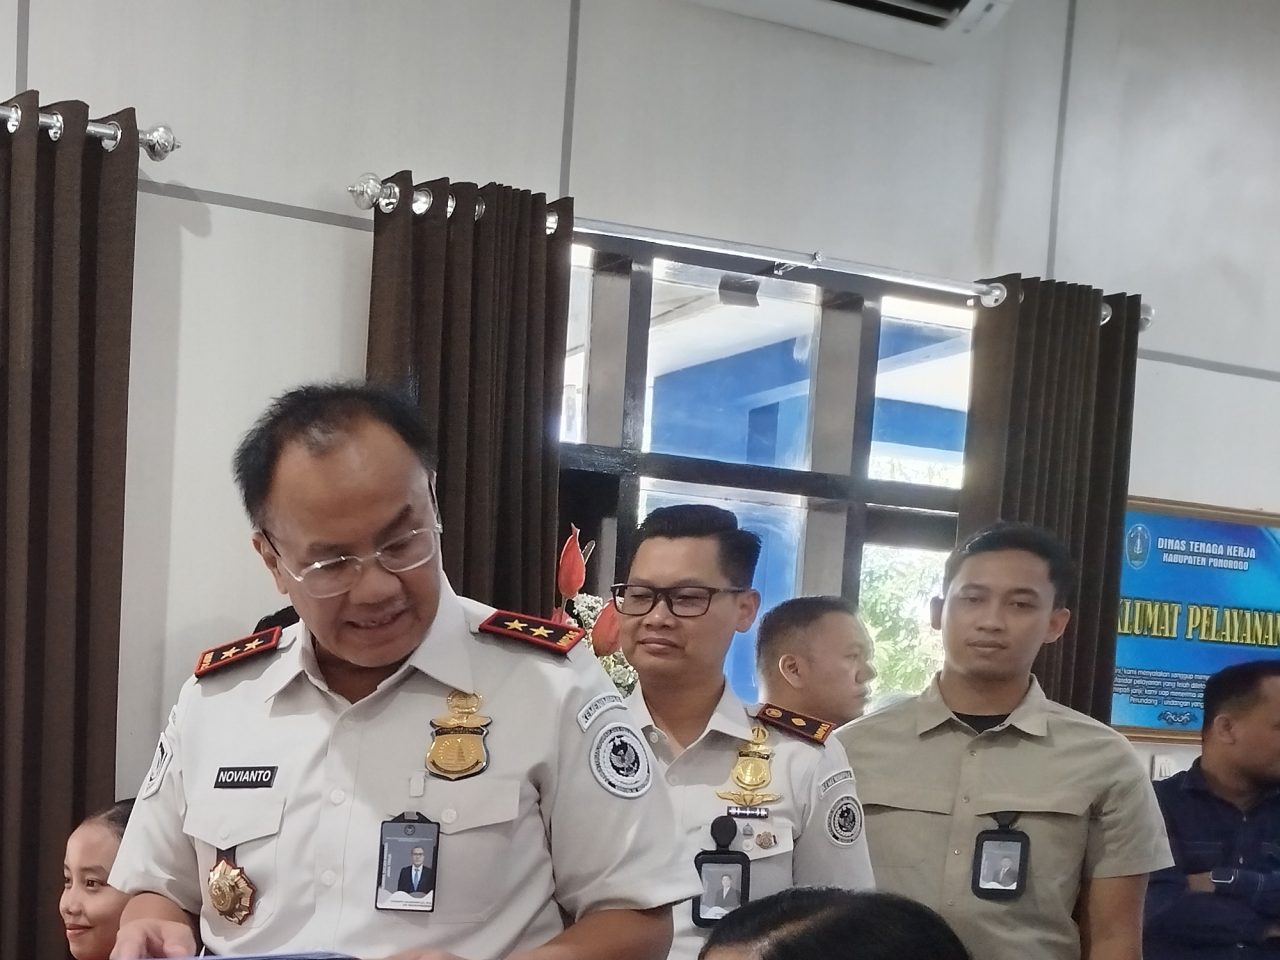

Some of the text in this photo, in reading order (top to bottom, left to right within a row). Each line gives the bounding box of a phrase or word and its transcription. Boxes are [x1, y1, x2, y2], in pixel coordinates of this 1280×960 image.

[1157, 537, 1256, 559] DINAS TENAGA KERJA
[1162, 552, 1249, 571] KABUPATEN PONOROGO
[1185, 605, 1280, 645] PELAYANA
[218, 769, 271, 782] NOVIANTO
